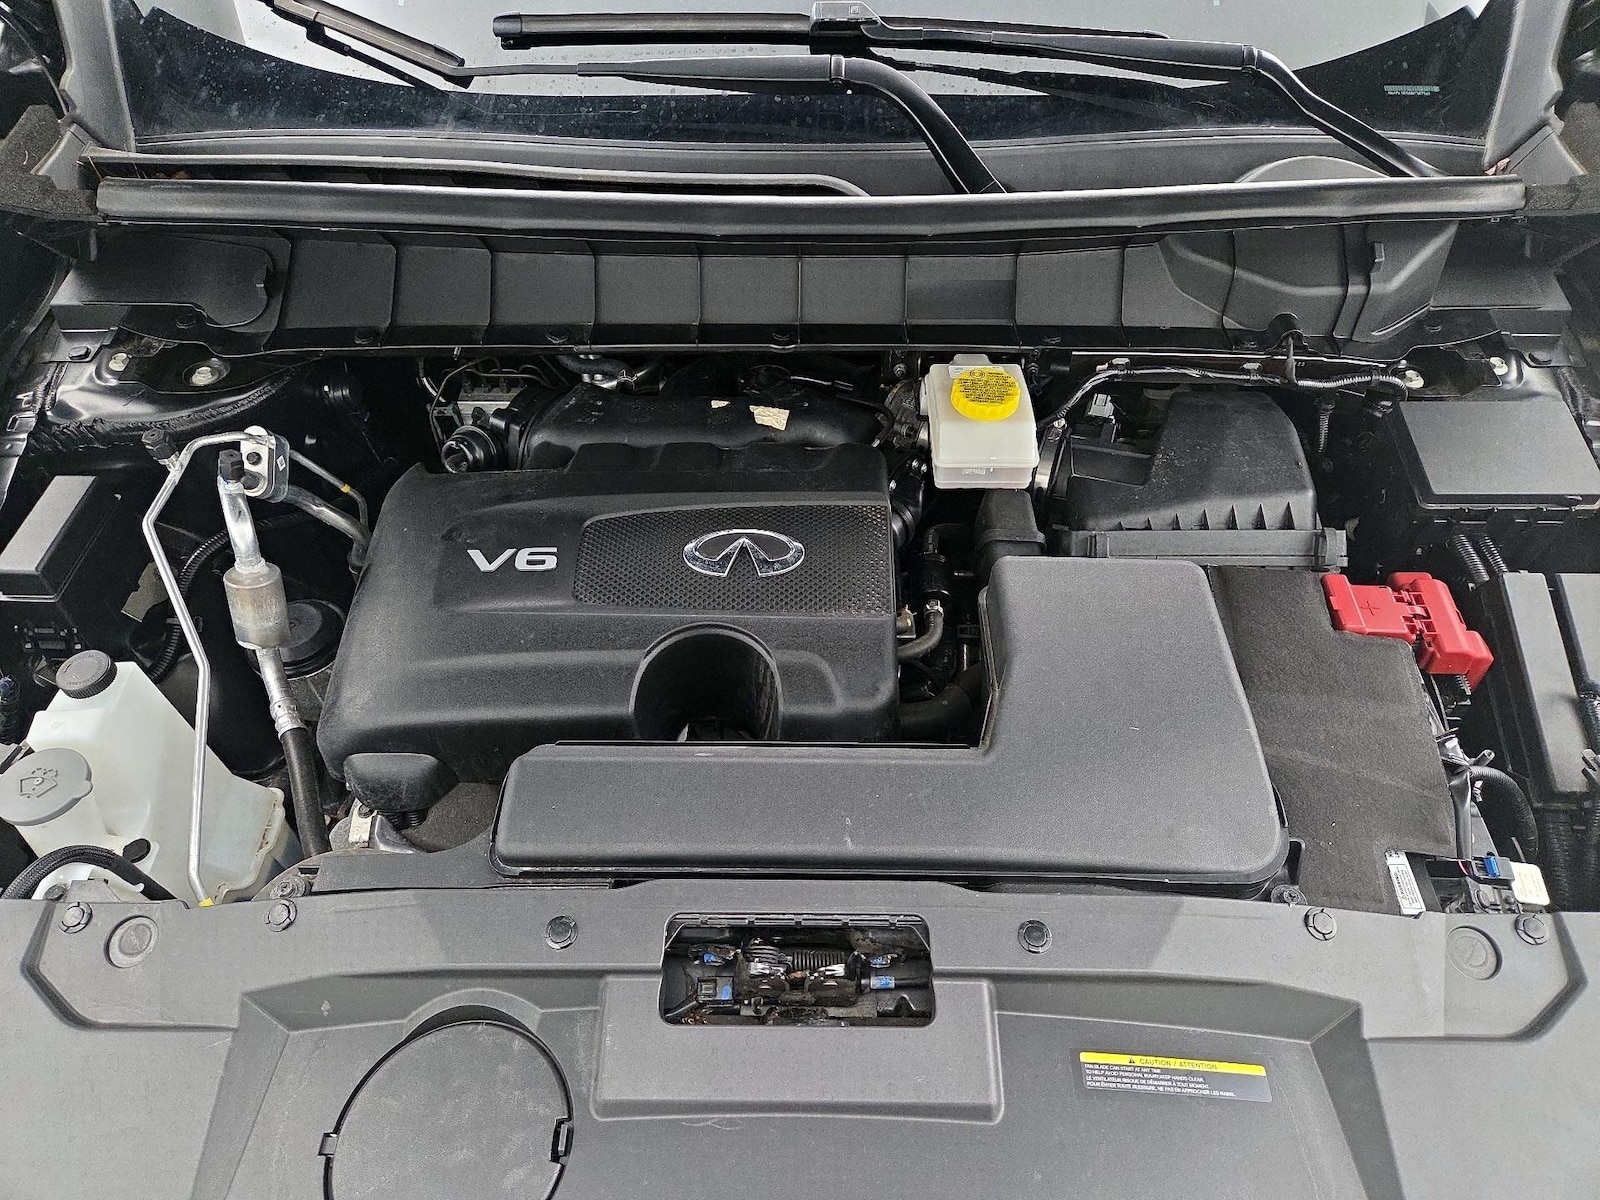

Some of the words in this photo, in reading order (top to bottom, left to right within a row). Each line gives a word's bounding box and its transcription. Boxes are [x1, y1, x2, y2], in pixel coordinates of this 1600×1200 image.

[467, 547, 557, 572] V6
[1140, 1058, 1171, 1067] CAUTION
[1179, 1061, 1218, 1070] ATTENTION
